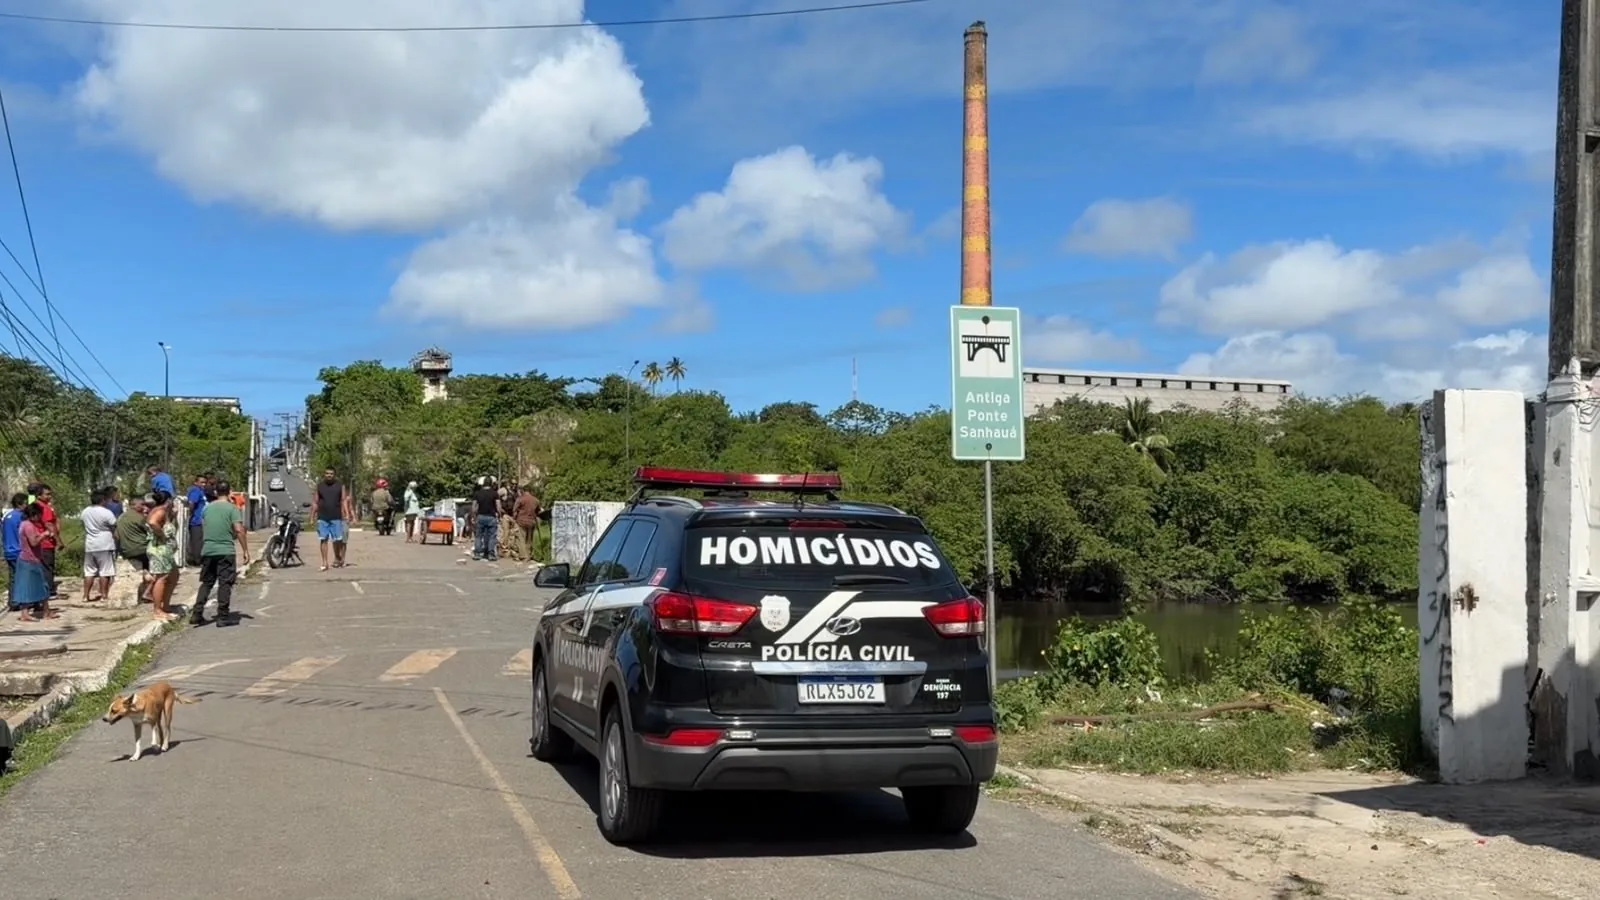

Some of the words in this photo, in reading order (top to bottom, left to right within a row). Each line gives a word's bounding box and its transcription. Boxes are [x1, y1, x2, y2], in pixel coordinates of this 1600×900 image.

[965, 391, 1011, 407] Antiga
[967, 409, 1009, 422] Ponte
[959, 425, 1018, 439] Sanhauá
[700, 533, 941, 570] HOMICÍDIOS
[708, 641, 752, 649] CRETA
[761, 641, 853, 661] POLÍCIA
[859, 645, 915, 661] CIVIL
[806, 683, 875, 699] RLX5J62
